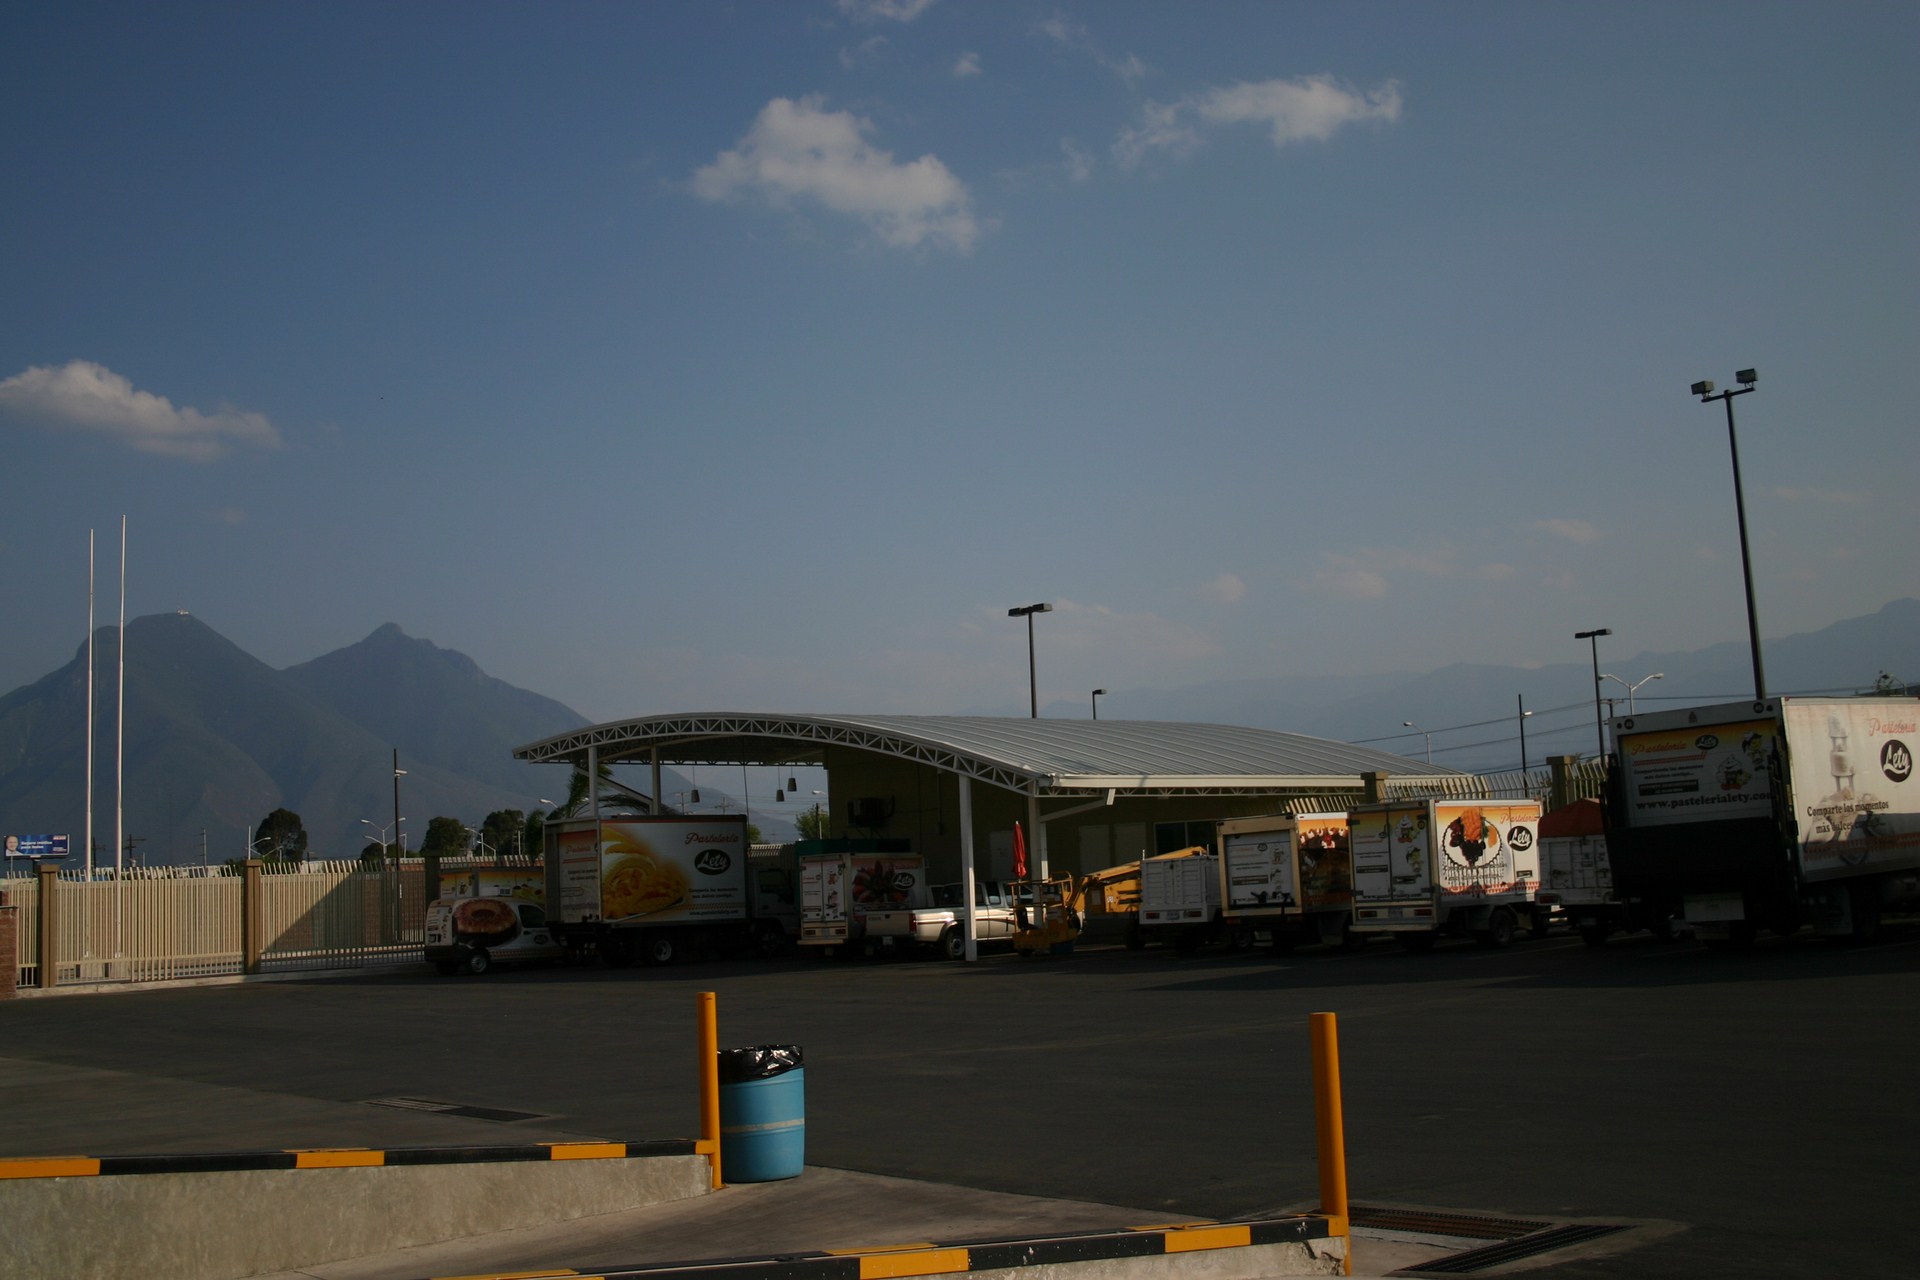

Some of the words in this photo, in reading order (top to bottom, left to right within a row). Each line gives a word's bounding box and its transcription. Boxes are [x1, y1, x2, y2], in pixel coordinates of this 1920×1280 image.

[1883, 744, 1911, 775] Lety
[1807, 803, 1843, 818] Comparte
[1844, 802, 1855, 813] los
[1855, 800, 1889, 812] momentos
[1509, 828, 1531, 848] Lety
[1816, 822, 1831, 834] más
[697, 851, 729, 871] Lety
